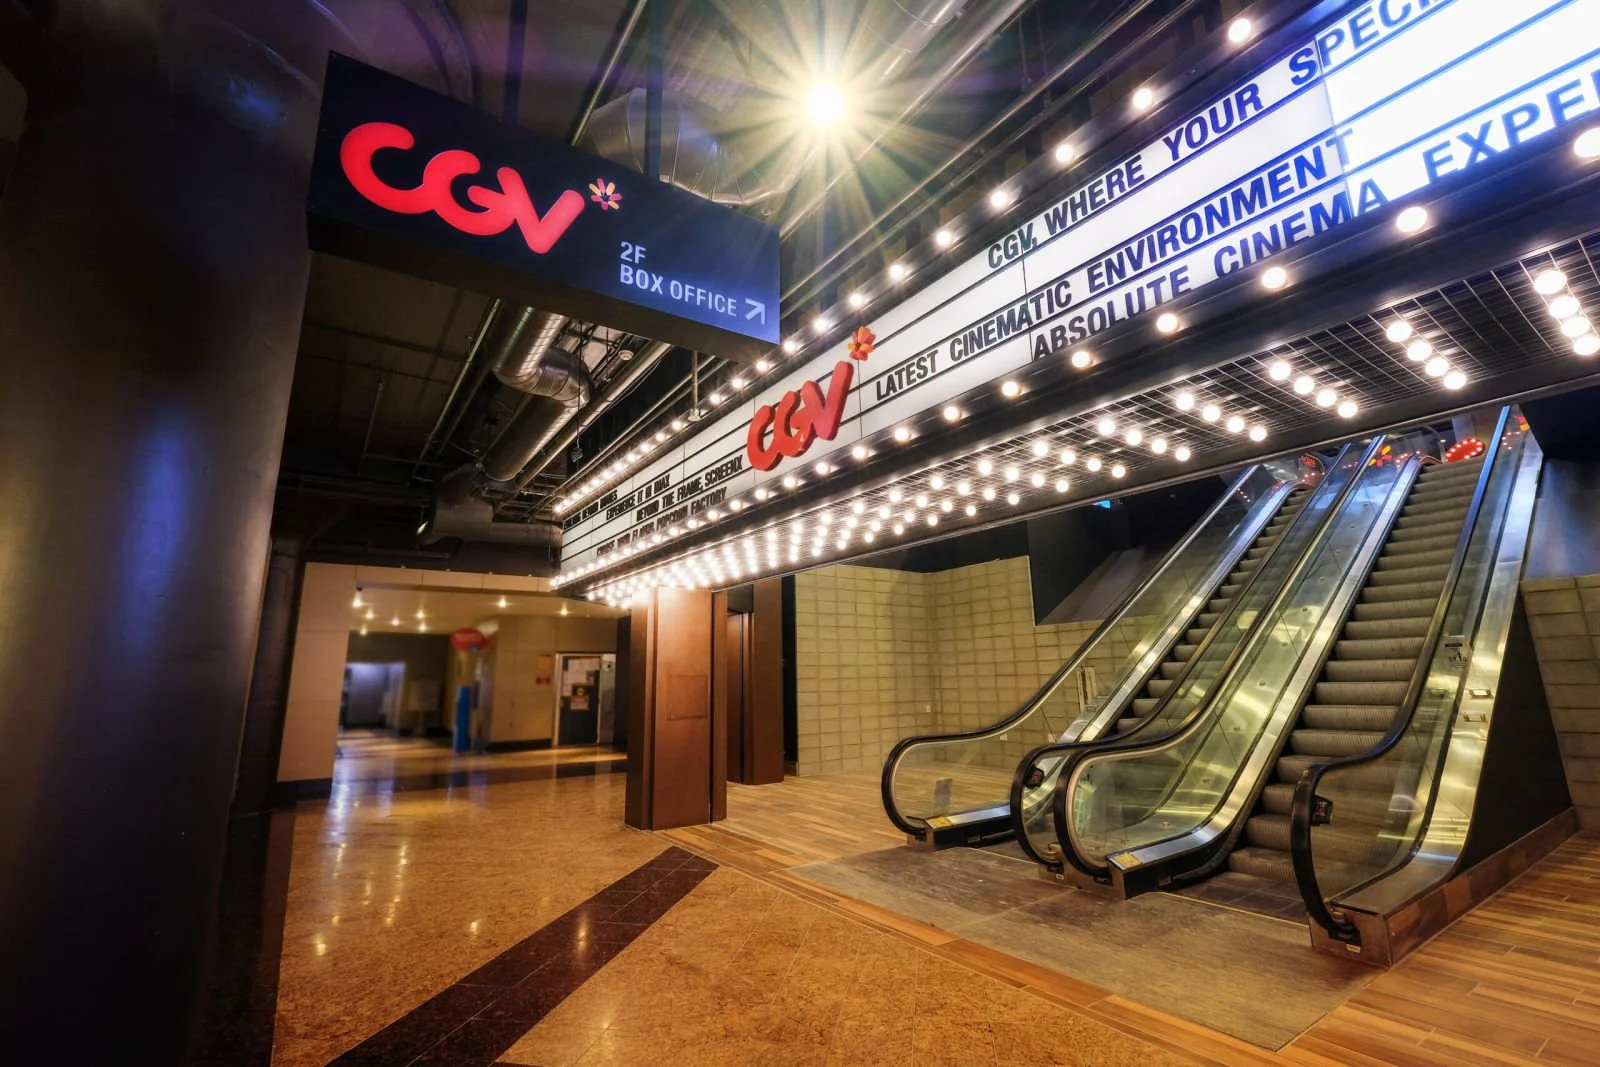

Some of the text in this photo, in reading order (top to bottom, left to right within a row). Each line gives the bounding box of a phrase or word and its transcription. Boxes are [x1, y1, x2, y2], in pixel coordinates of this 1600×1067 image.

[340, 122, 585, 254] CGV
[988, 0, 1438, 269] CGV, WHERE YOUR SPEC
[620, 241, 646, 264] 2F
[620, 264, 738, 317] BOX OFFICE
[876, 128, 1354, 400] LATEST CINEMATIC ENVIRONMENT
[1033, 265, 1193, 361] ABSOLUTE
[1214, 178, 1389, 279] CINEMA
[747, 361, 854, 471] CGV
[662, 491, 675, 509] THE
[704, 454, 743, 487] SCREENX
[691, 486, 728, 516] FACTORY
